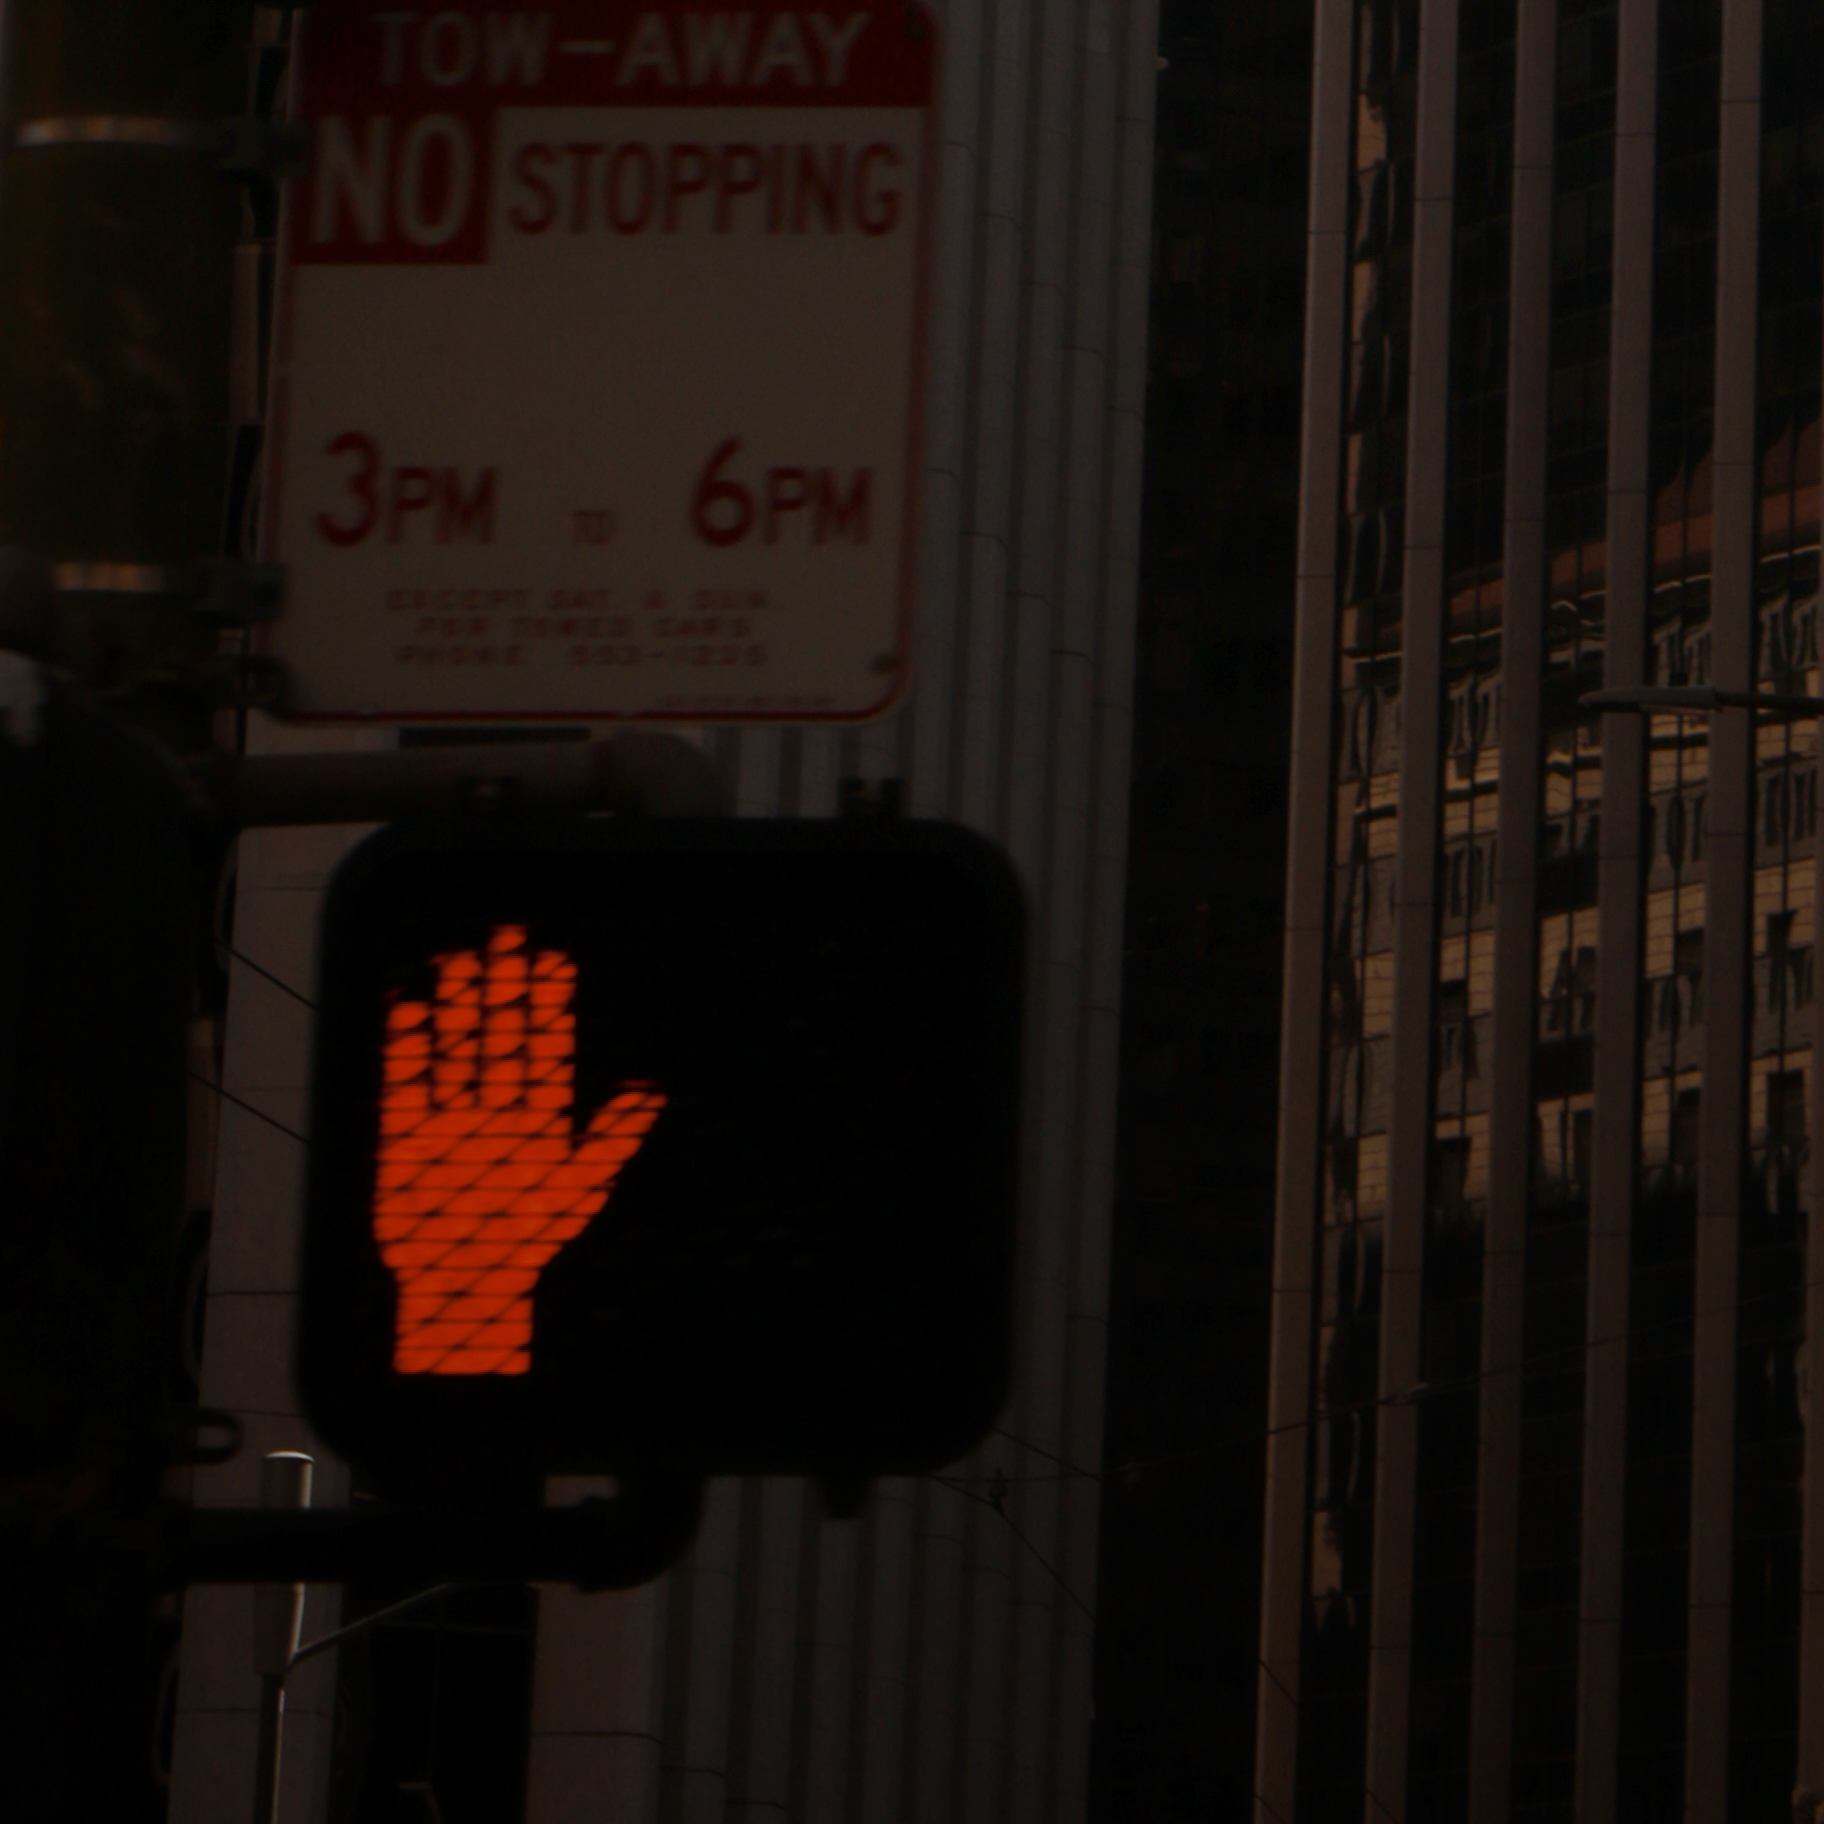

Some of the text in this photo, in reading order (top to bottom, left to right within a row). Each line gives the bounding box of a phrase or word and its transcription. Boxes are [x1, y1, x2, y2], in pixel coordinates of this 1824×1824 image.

[370, 9, 873, 88] TOW-AWAY
[310, 112, 903, 247] NO STOPPING
[315, 432, 499, 548] 3PM
[692, 436, 872, 547] 6PM
[654, 616, 752, 638] CARS
